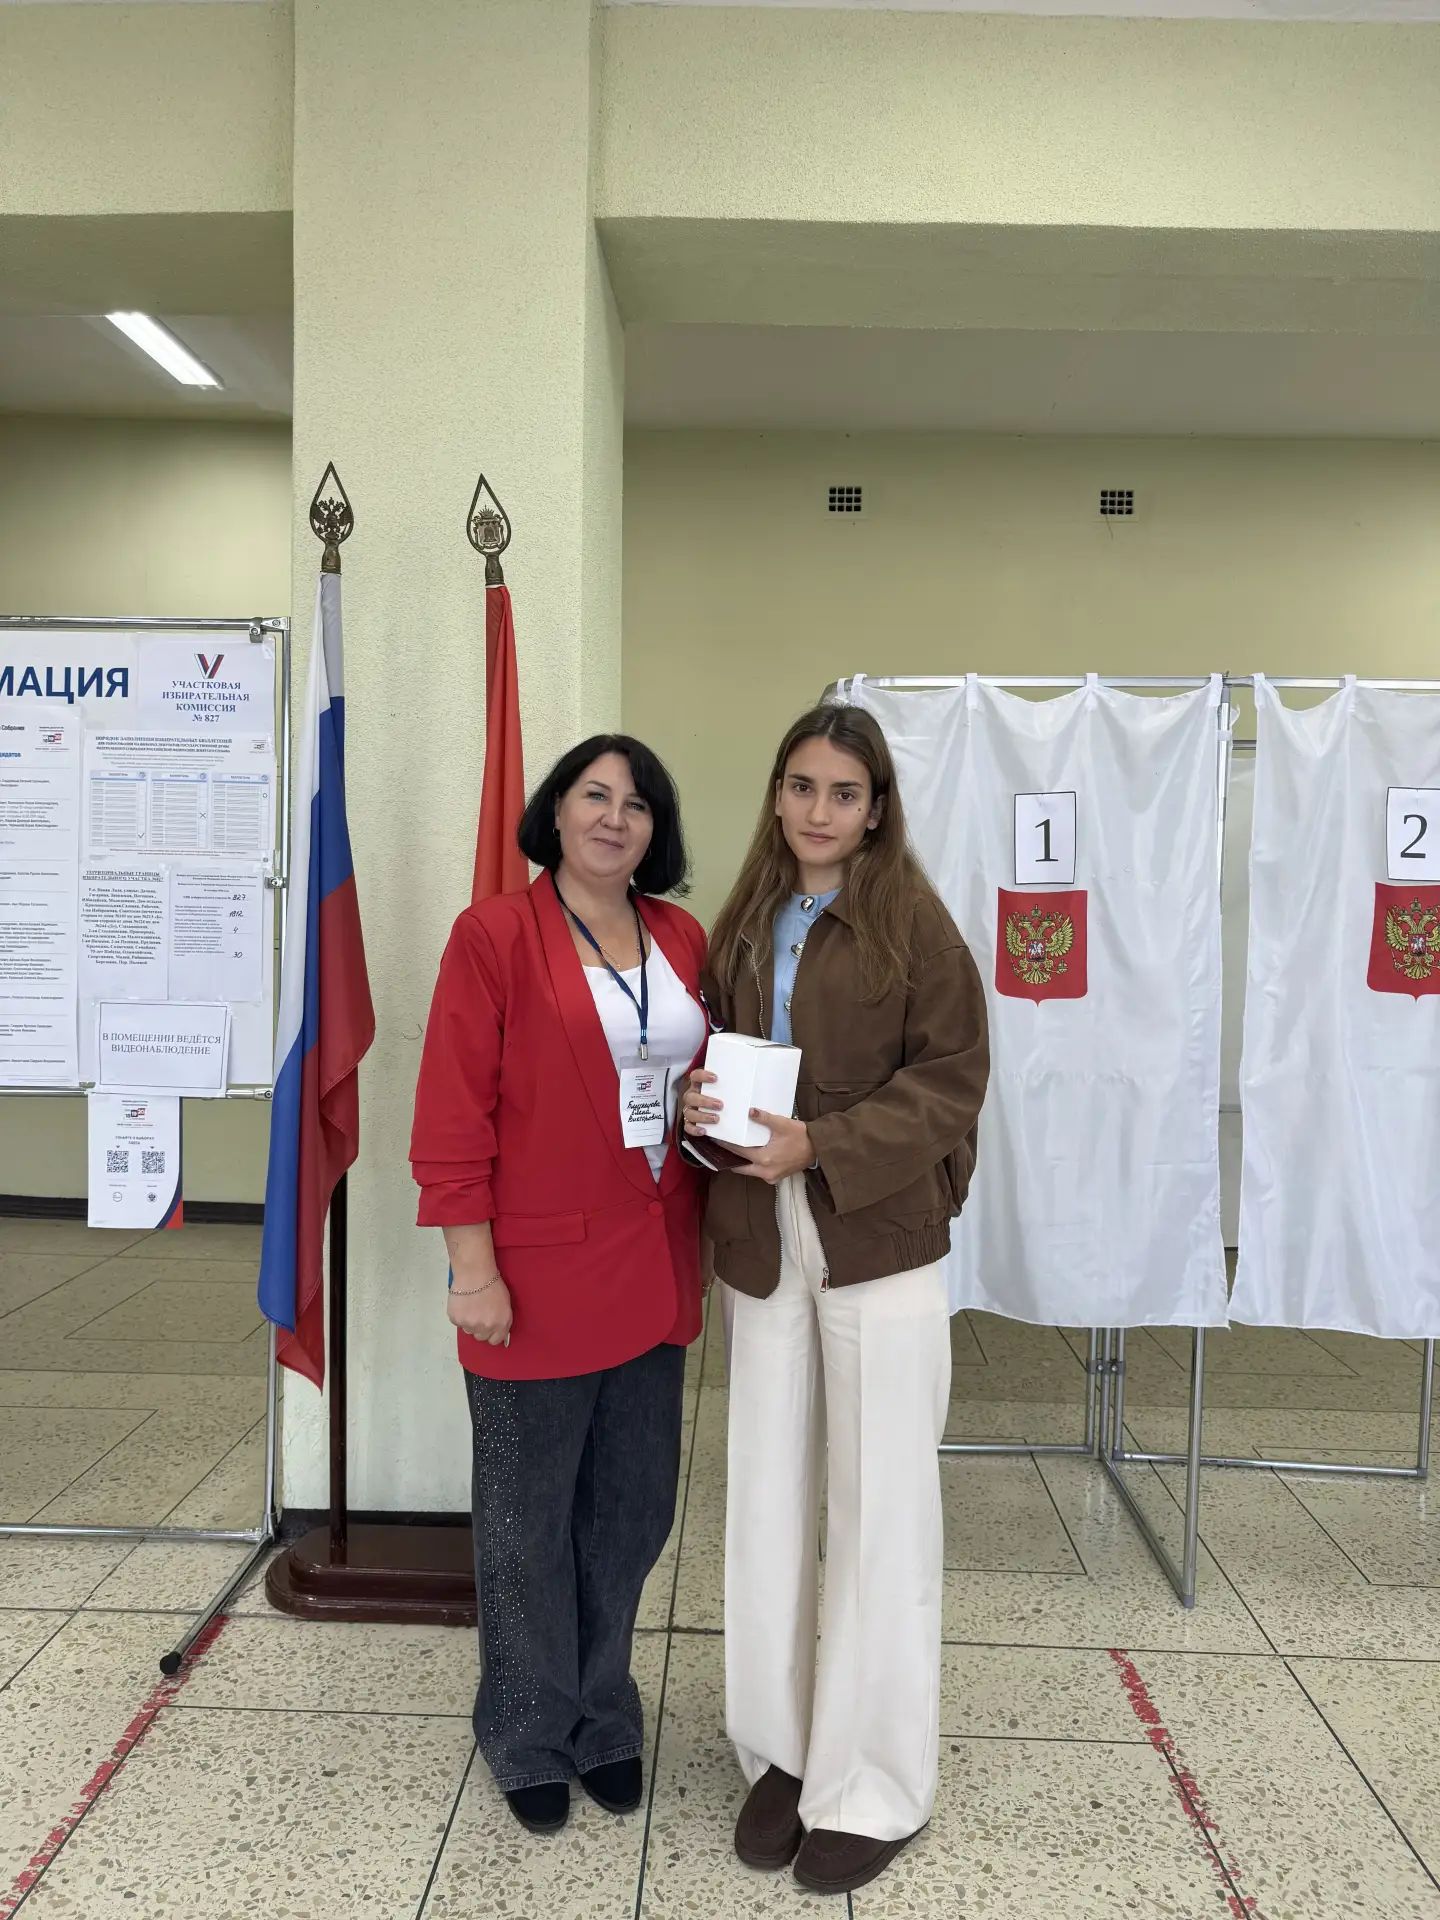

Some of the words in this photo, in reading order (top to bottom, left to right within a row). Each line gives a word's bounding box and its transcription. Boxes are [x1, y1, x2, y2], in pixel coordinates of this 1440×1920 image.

[172, 680, 241, 690] УЧАСТКОВАЯ
[162, 691, 250, 701] ИЗБИРАТЕЛЬНАЯ
[176, 703, 236, 712] КОМИССИЯ
[192, 713, 203, 722] №
[204, 714, 220, 722] 827
[1034, 818, 1059, 863] 1
[1400, 814, 1429, 860] 2
[232, 893, 246, 901] 827
[233, 951, 243, 959] 30
[102, 1032, 109, 1041] В
[111, 1032, 174, 1043] ПОМЕЩЕНИИ
[177, 1034, 221, 1044] ВЕДЁТСЯ
[111, 1044, 211, 1055] ВИДЕОНАБЛЮДЕНИЕ
